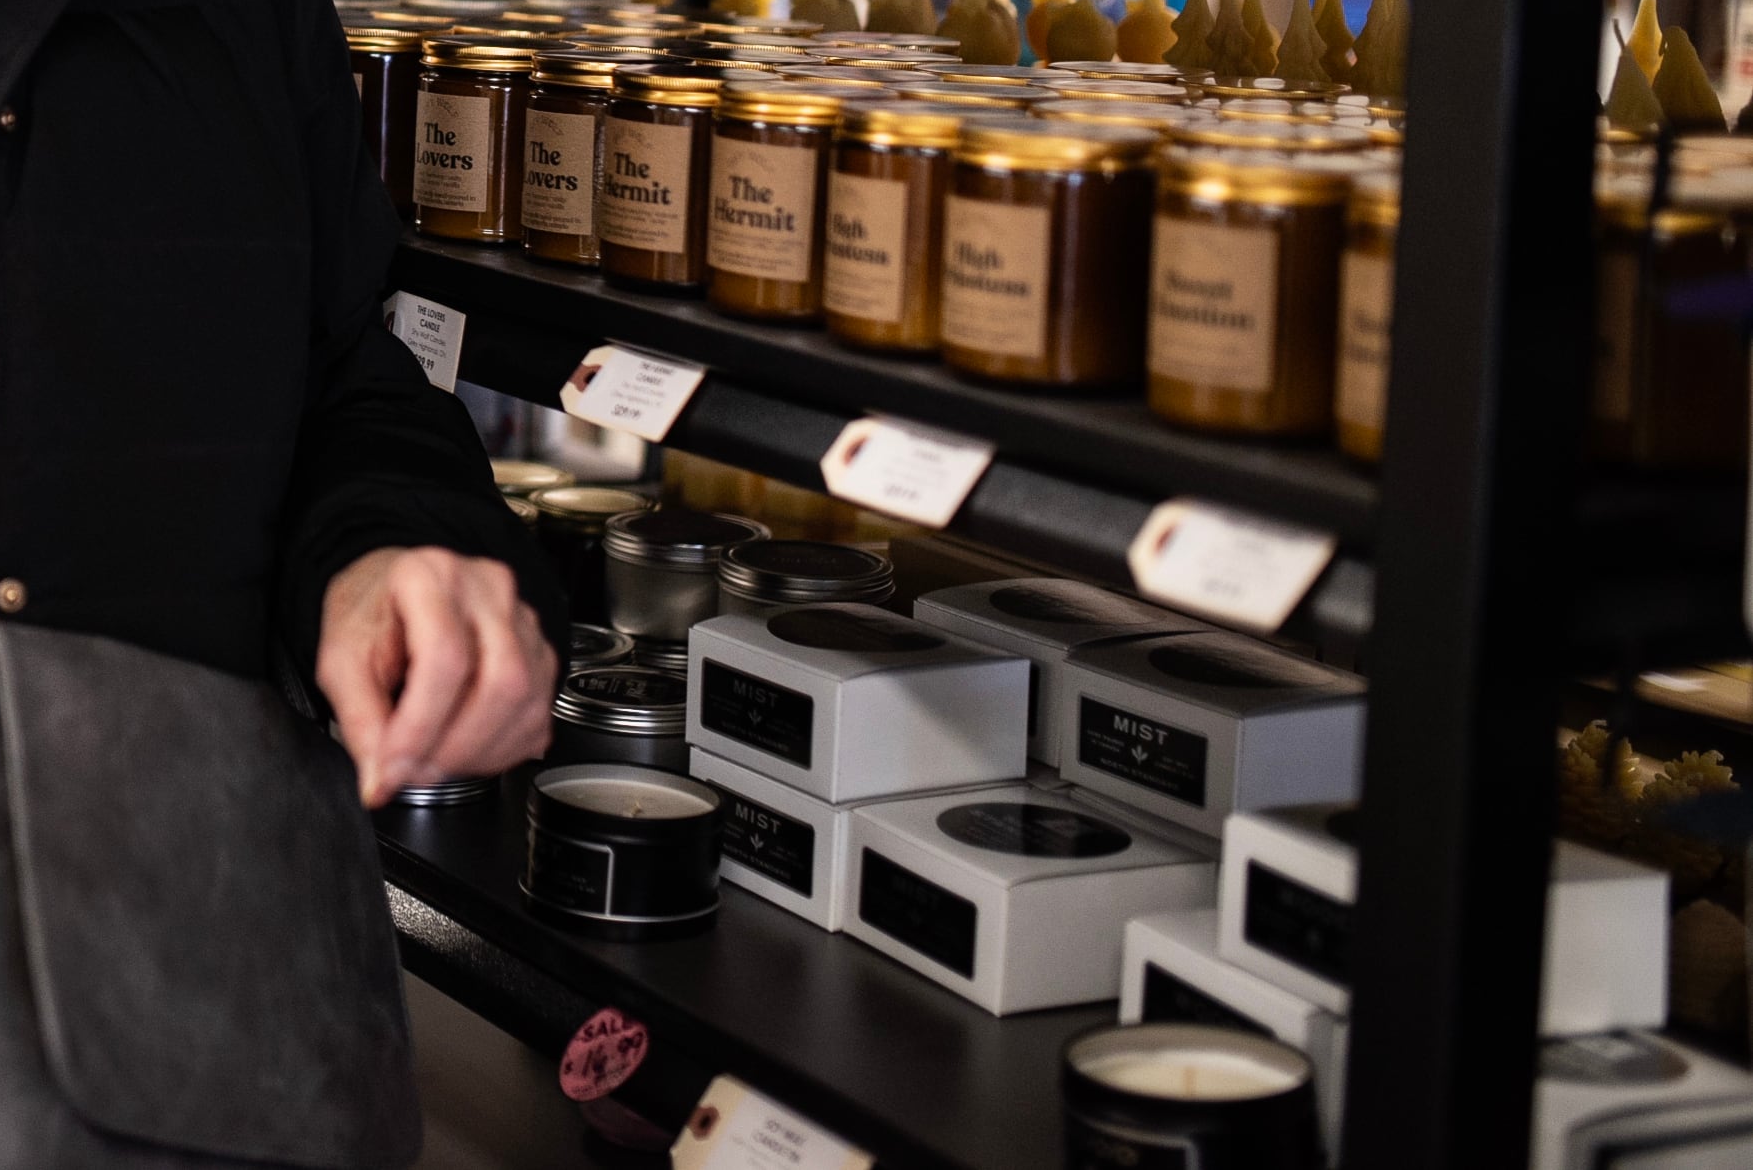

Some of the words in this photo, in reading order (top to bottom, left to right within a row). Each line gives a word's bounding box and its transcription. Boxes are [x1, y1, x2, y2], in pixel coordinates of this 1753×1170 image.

[424, 122, 457, 146] The
[416, 142, 474, 171] Lovers
[530, 141, 562, 166] The
[614, 152, 650, 179] The
[604, 174, 671, 205] Hermit
[728, 174, 774, 204] The
[714, 196, 795, 232] Hermit
[417, 304, 427, 317] THE
[427, 308, 446, 323] LOVERS
[419, 318, 441, 333] CANDLE
[733, 678, 779, 709] MIST
[1113, 714, 1168, 745] MIST
[735, 802, 781, 835] MIST
